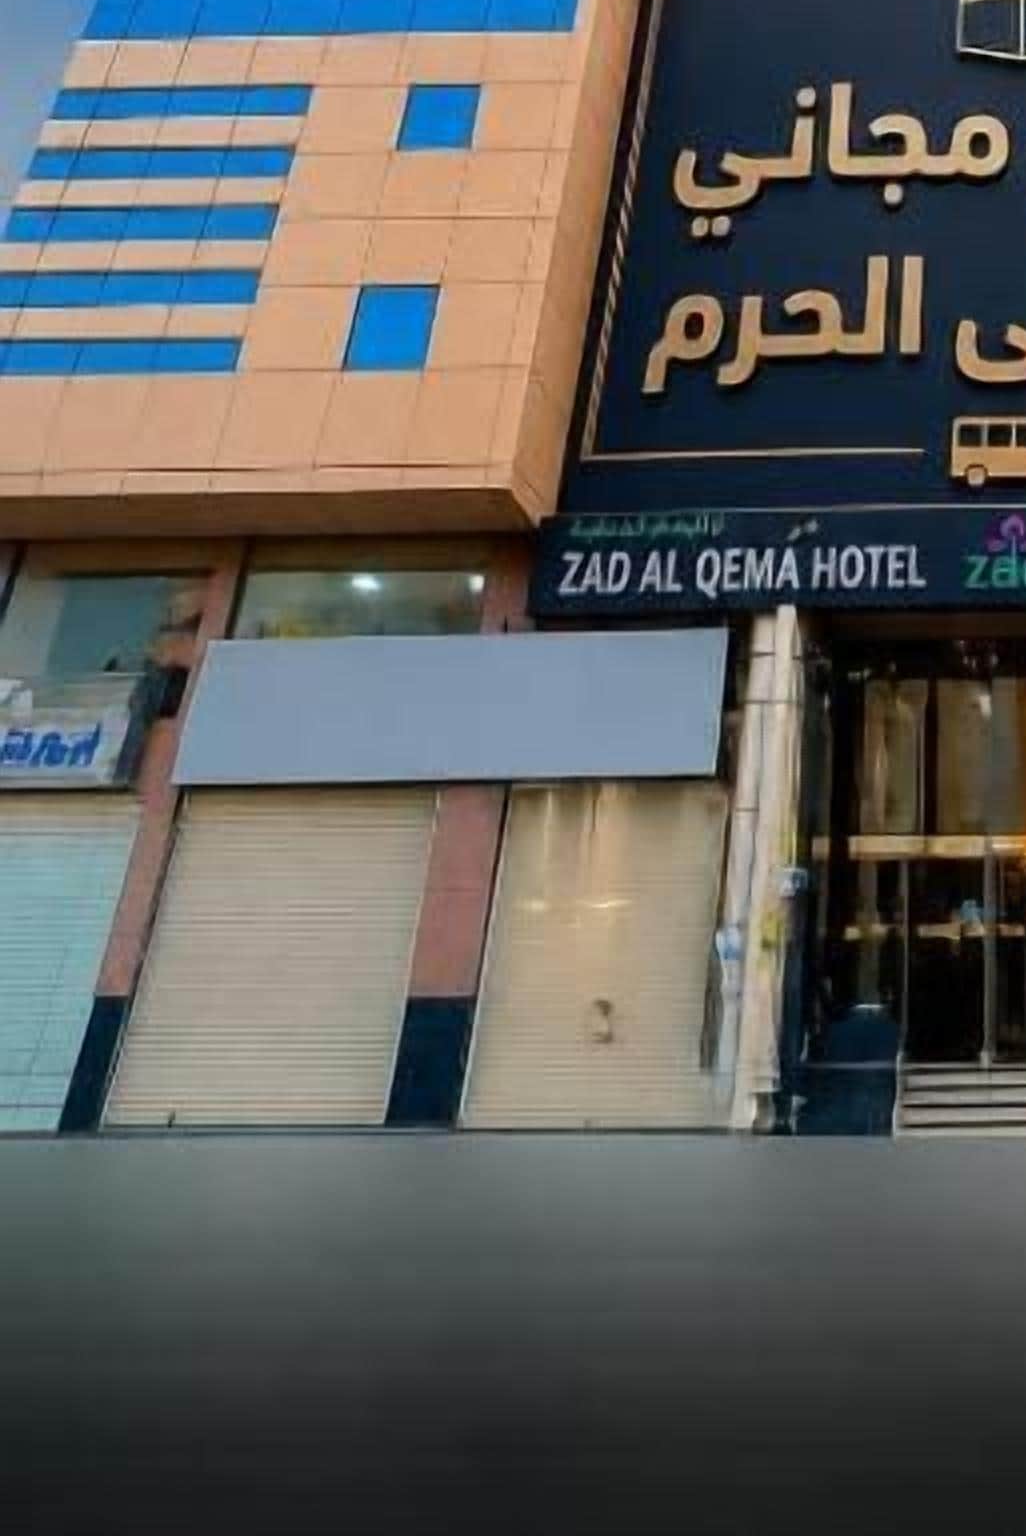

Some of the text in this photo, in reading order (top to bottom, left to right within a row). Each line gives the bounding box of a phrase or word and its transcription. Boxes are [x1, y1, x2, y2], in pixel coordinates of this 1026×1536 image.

[672, 81, 1009, 237] مجاني
[641, 255, 924, 394] الحرم
[558, 550, 630, 596] ZAD
[638, 548, 683, 594] AL
[811, 545, 927, 590] HOTEL
